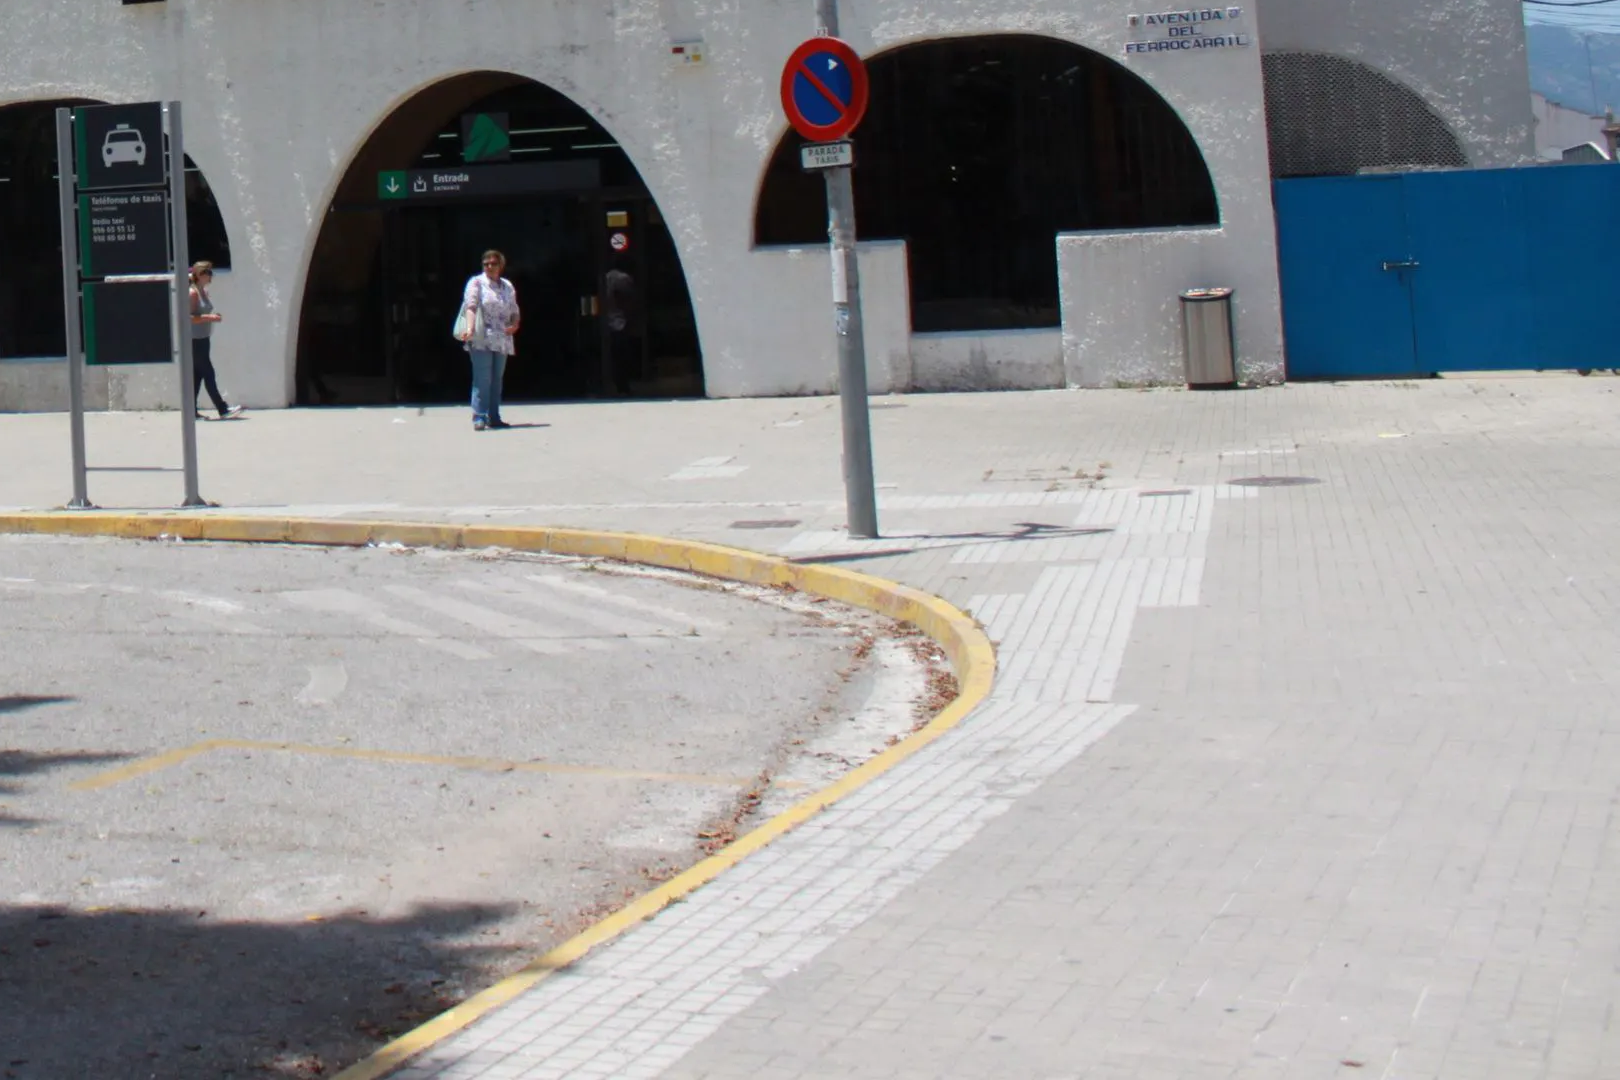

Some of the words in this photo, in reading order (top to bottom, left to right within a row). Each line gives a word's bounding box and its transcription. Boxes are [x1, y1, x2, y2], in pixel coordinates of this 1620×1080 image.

[1145, 10, 1223, 25] AVENIDA
[1168, 24, 1202, 37] DEL
[1126, 35, 1248, 54] FERROCARRIL
[808, 146, 844, 156] PARADA
[433, 173, 469, 183] Entrada
[130, 195, 140, 203] de
[142, 193, 162, 203] taxis
